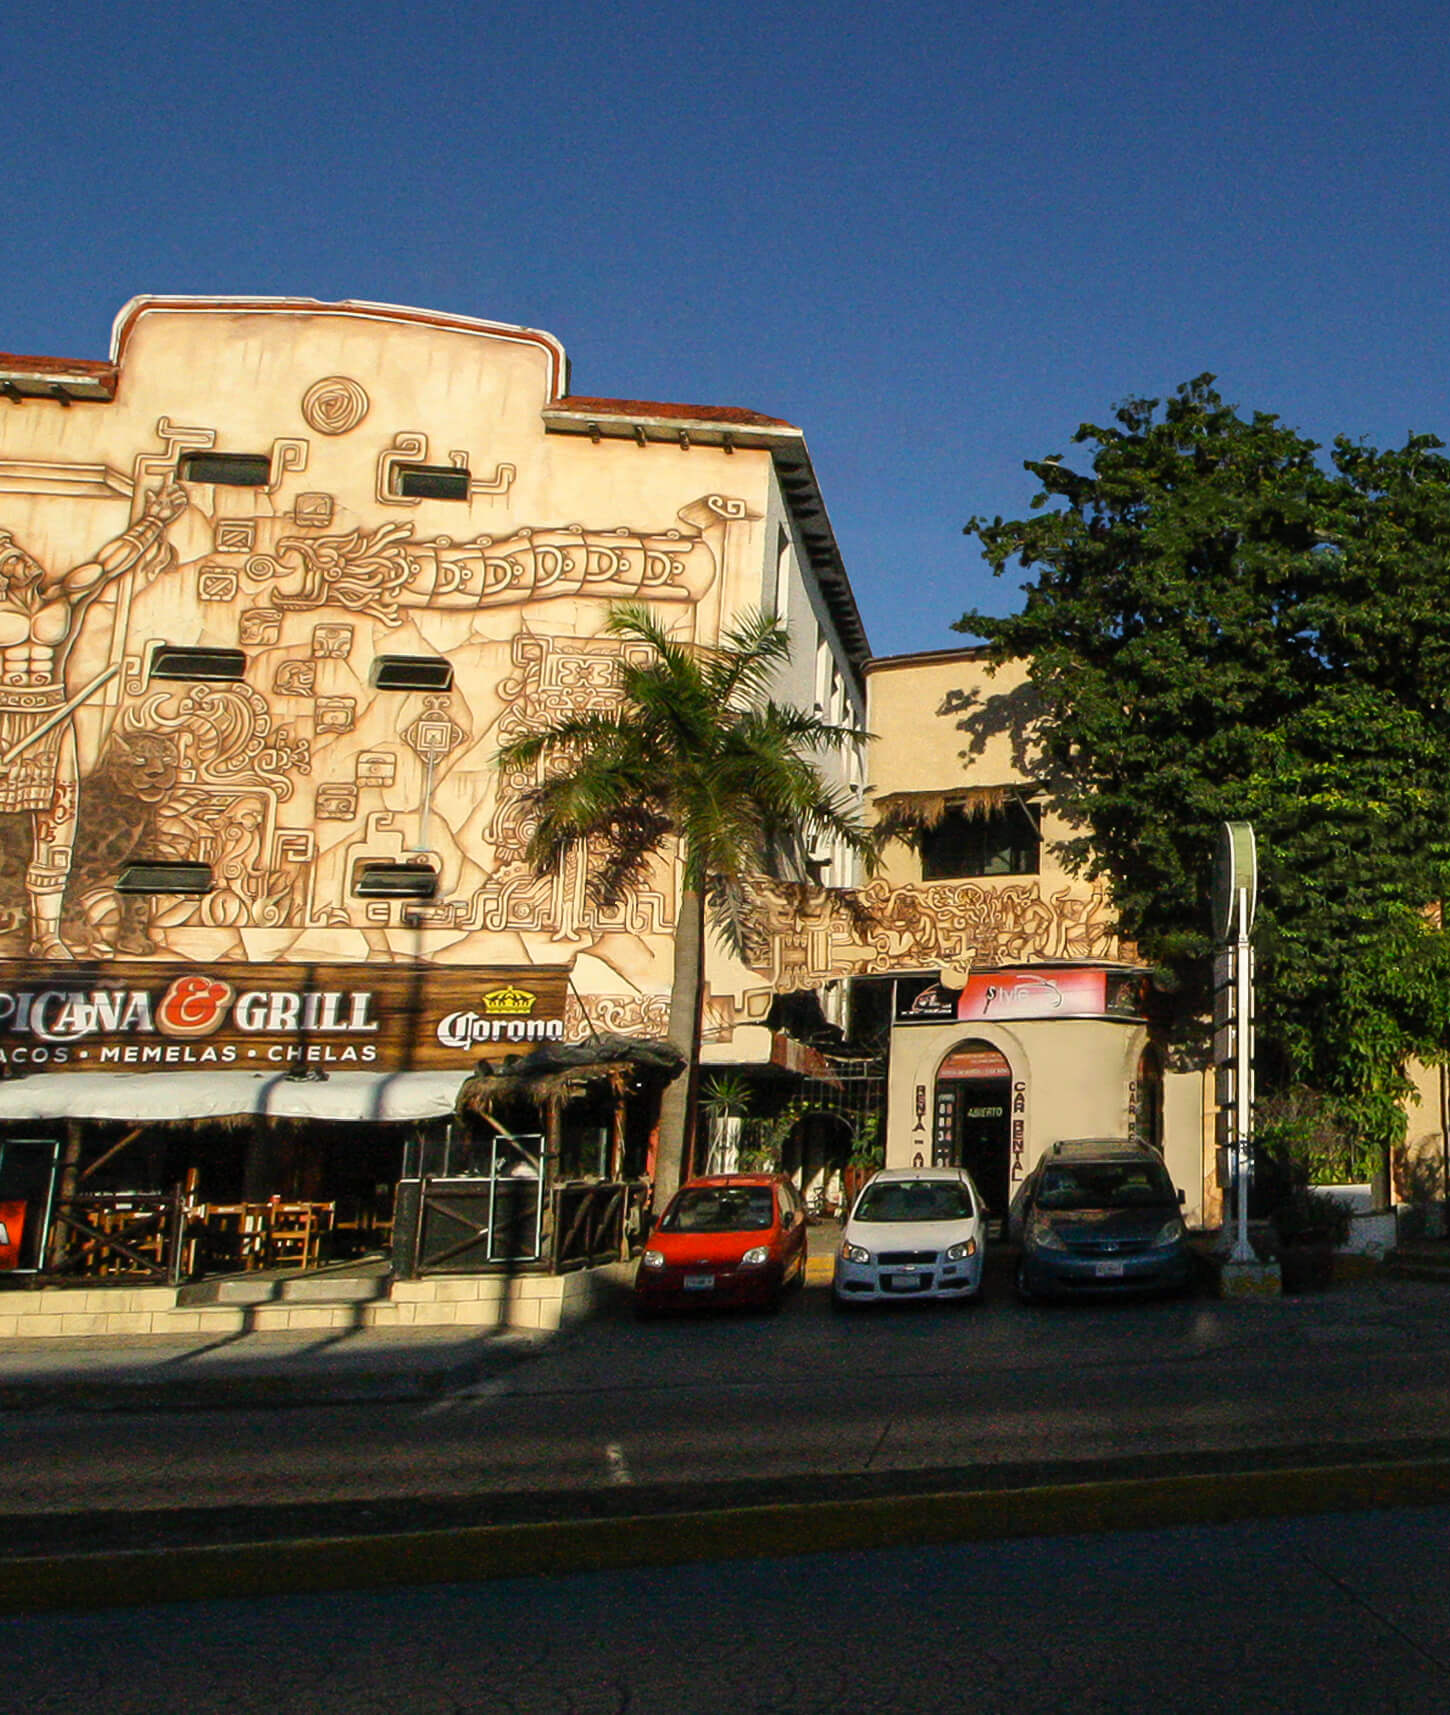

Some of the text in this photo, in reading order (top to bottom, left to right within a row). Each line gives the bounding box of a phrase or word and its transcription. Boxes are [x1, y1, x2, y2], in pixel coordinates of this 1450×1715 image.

[160, 975, 234, 1034] &
[234, 991, 379, 1032] GRILL
[100, 1046, 237, 1063] MEMELAS
[267, 1045, 377, 1062] CHELAS
[437, 1011, 564, 1051] Corona
[1011, 1081, 1026, 1182] CAR RENTAL
